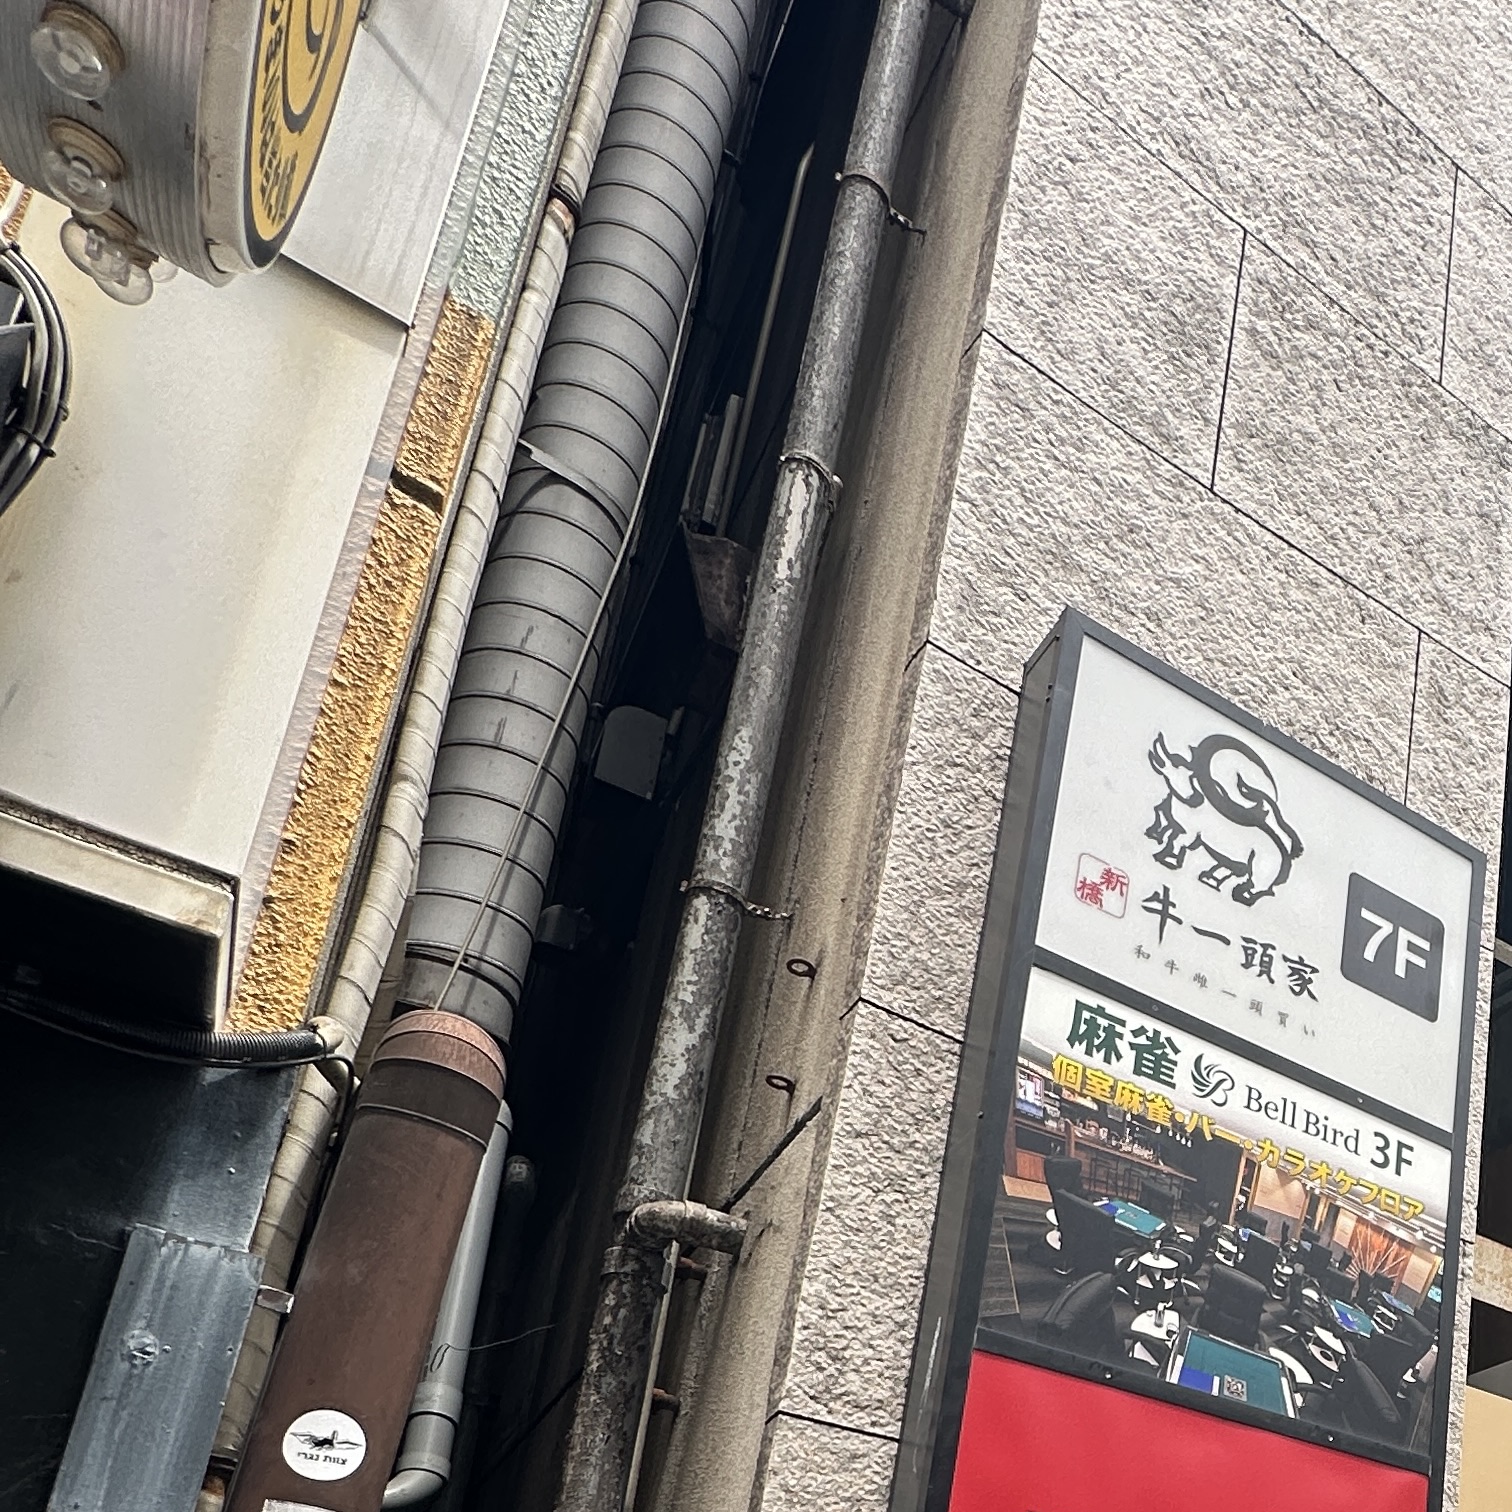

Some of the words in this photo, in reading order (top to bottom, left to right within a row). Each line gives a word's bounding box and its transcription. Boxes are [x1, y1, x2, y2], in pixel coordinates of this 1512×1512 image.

[1141, 884, 1320, 1004] 牛一頭家
[1358, 906, 1432, 980] 7F
[1066, 998, 1181, 1090] 麻雀
[1369, 1130, 1416, 1178] 3F
